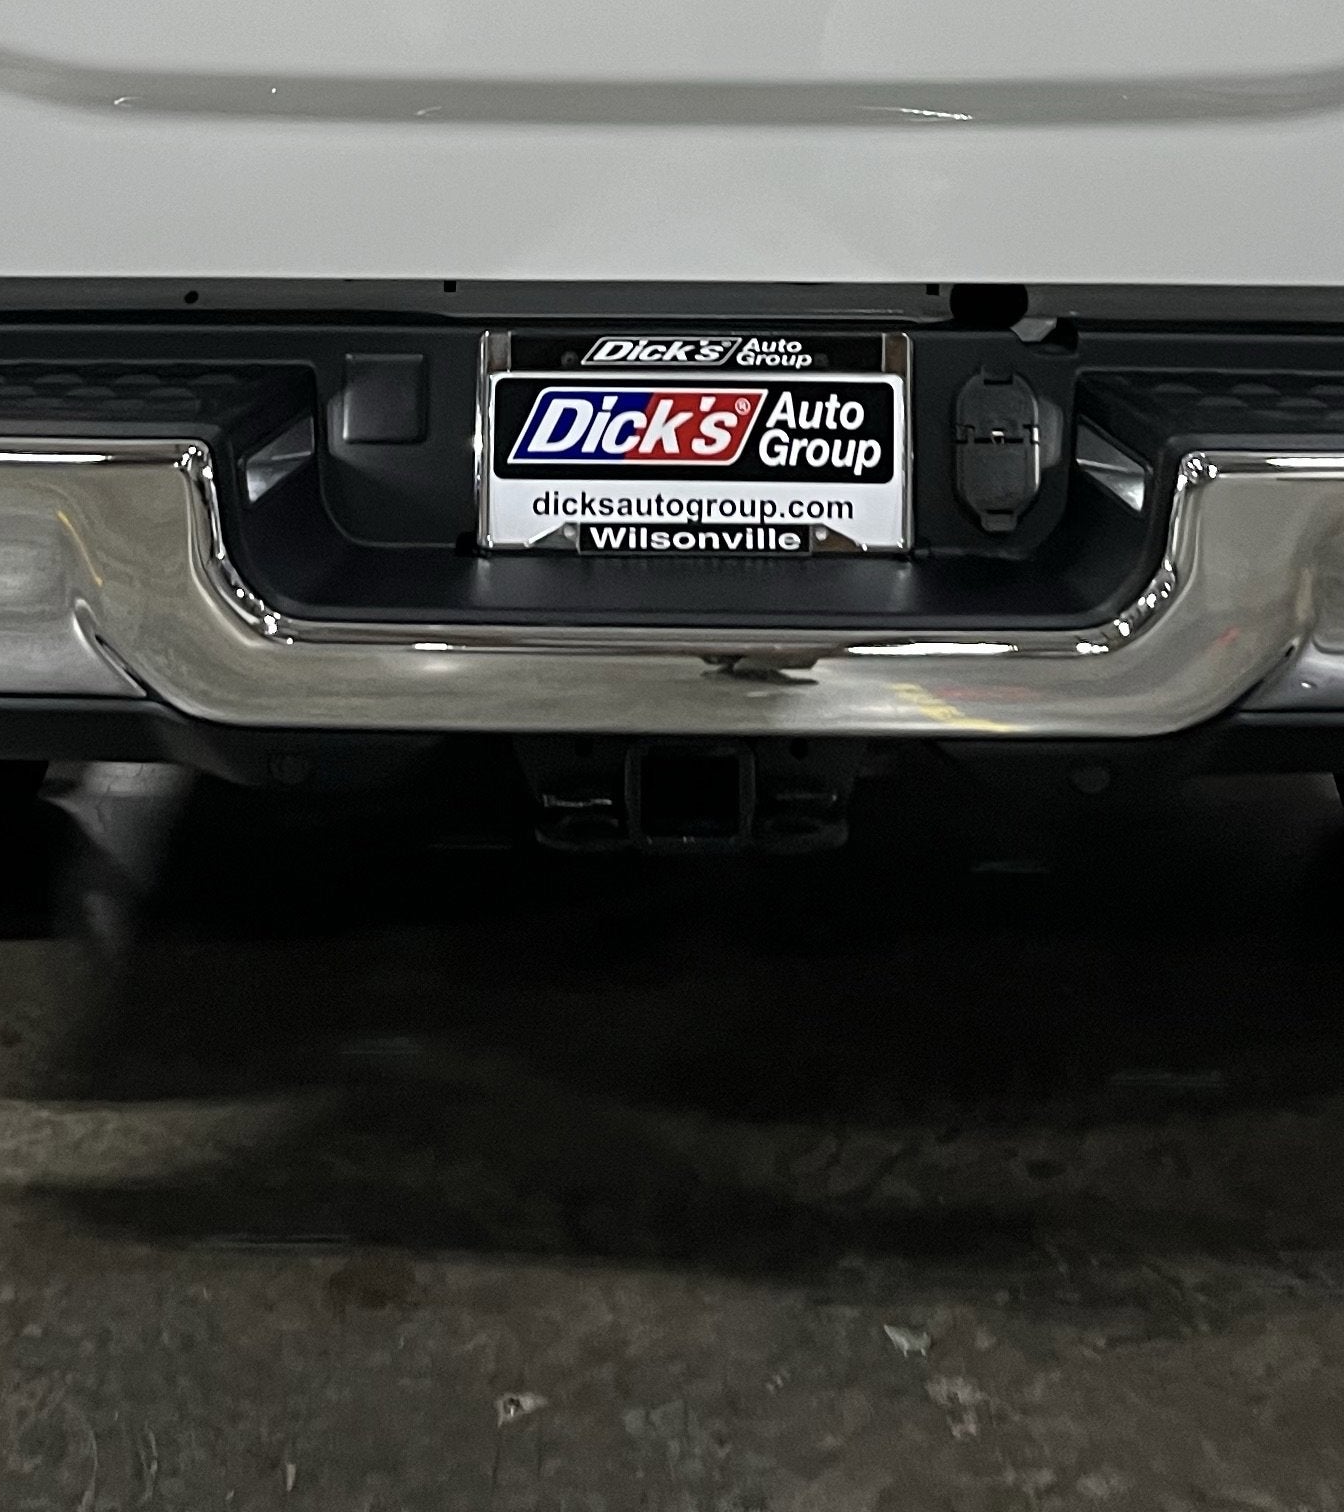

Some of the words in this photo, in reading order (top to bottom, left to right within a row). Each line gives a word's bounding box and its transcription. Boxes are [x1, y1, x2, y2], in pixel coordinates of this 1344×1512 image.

[742, 338, 802, 353] Auto
[736, 352, 812, 369] Group
[765, 392, 865, 431] Auto
[758, 429, 882, 476] Group
[533, 491, 854, 522] dicksautogroup.com
[590, 527, 801, 550] Wilsonville
